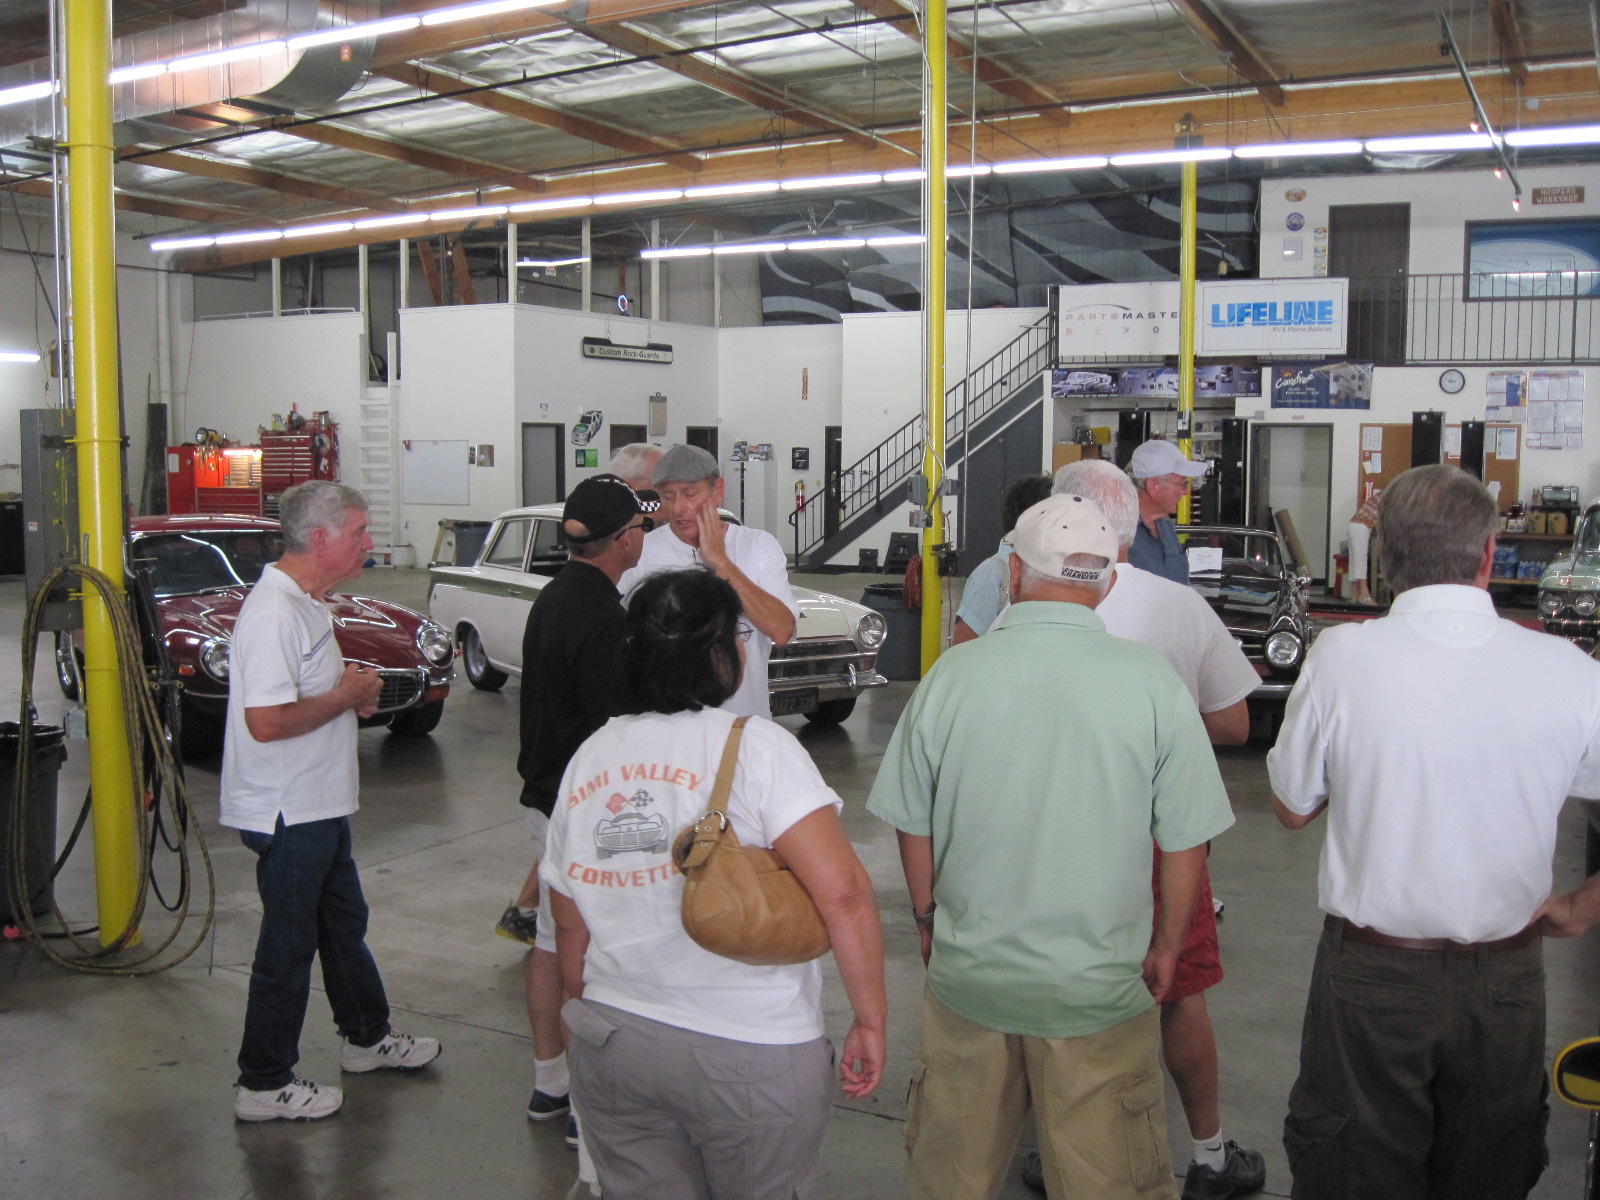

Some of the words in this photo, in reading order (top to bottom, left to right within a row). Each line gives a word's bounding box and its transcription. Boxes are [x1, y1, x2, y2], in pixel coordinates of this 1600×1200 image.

[1536, 195, 1579, 204] WORKSHOP
[1066, 311, 1179, 321] PARTSMASTE
[1211, 300, 1334, 327] LIFELINE
[599, 347, 622, 356] Custom
[1275, 370, 1315, 389] Carefree
[1061, 569, 1099, 580] CHARGERS
[567, 769, 611, 811] SIMI
[620, 763, 704, 792] VALLEY
